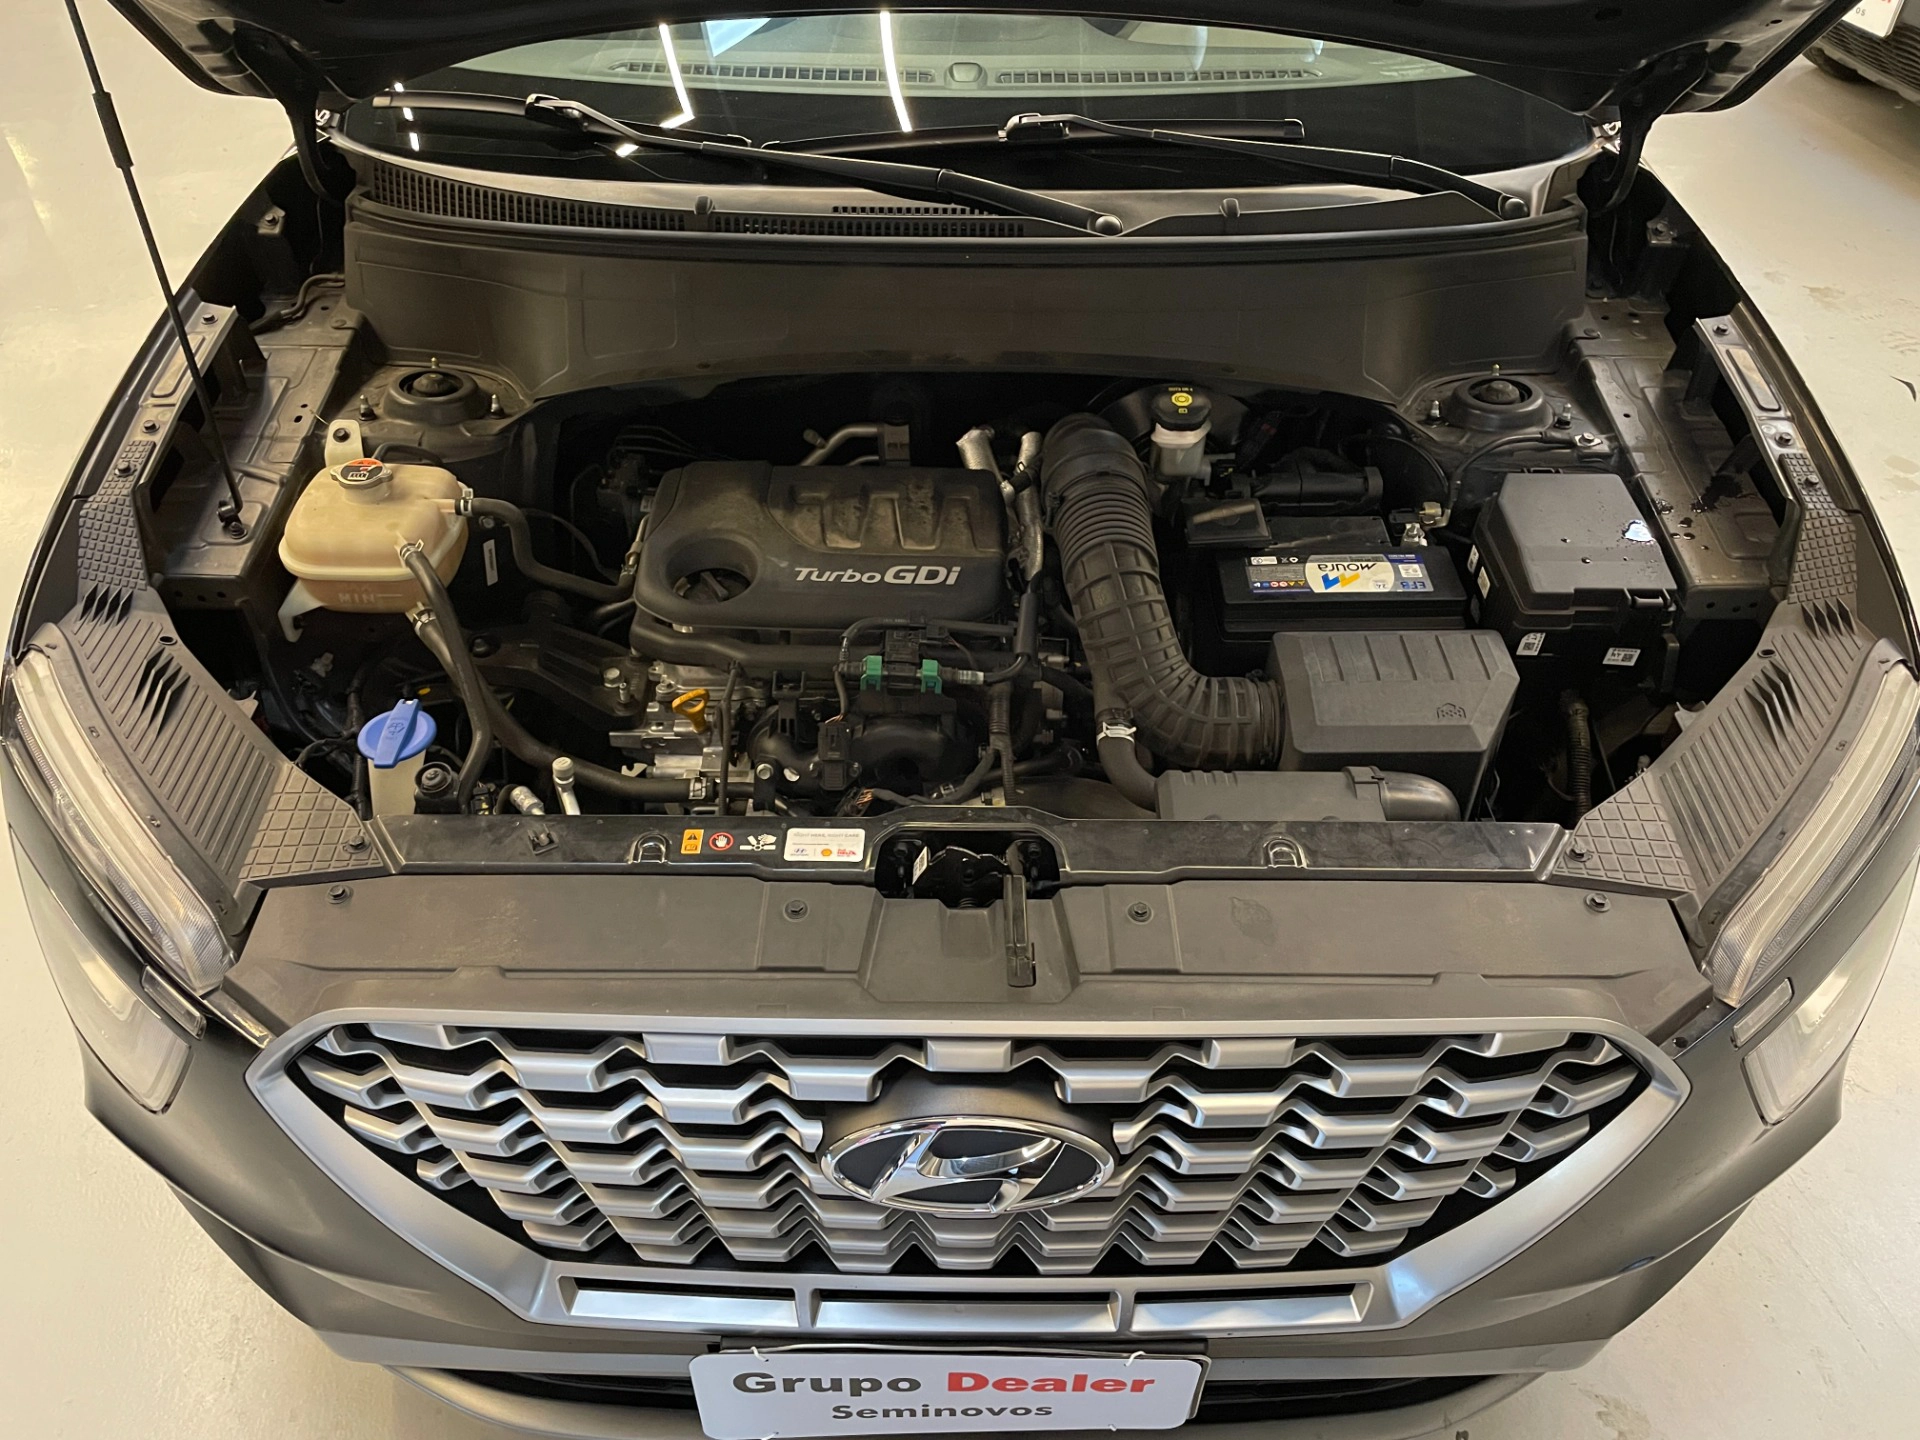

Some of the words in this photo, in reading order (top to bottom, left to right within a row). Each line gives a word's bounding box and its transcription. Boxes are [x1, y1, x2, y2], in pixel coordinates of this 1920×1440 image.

[732, 1371, 922, 1397] Grupo
[947, 1371, 1156, 1393] Dealer
[831, 1404, 1053, 1420] Seminovos
